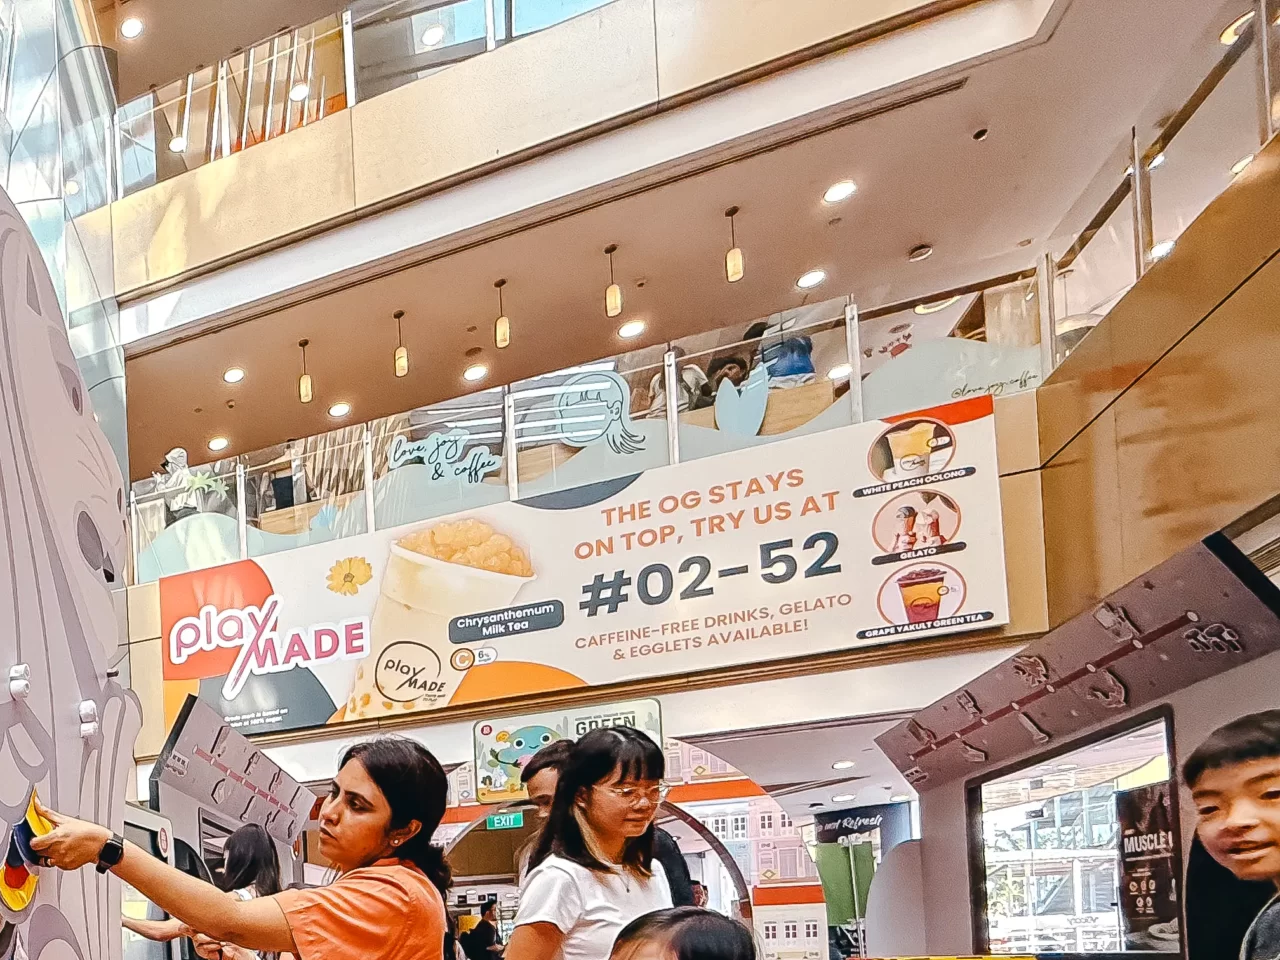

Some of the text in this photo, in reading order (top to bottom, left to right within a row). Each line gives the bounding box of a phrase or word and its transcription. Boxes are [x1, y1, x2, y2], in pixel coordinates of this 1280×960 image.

[431, 452, 496, 483] & coffee
[862, 469, 966, 496] WHITE PEACH OOLONG
[601, 469, 804, 526] THE OG STAYS
[574, 491, 840, 560] ON TOP, TRY US AT
[900, 548, 937, 559] GELATO
[579, 531, 842, 617] #02-52
[457, 604, 554, 628] Chrysanthemum
[482, 619, 529, 636] Milk Tea
[574, 593, 852, 649] CAFFEINE-FREE DRINKS, GELATO
[865, 613, 984, 638] GRAPE YAKULT GREEN TEA
[256, 622, 364, 669] MADE
[613, 618, 809, 661] & EGGLETS AVAILABLE!
[408, 678, 446, 693] MADE
[494, 814, 515, 828] EXIT
